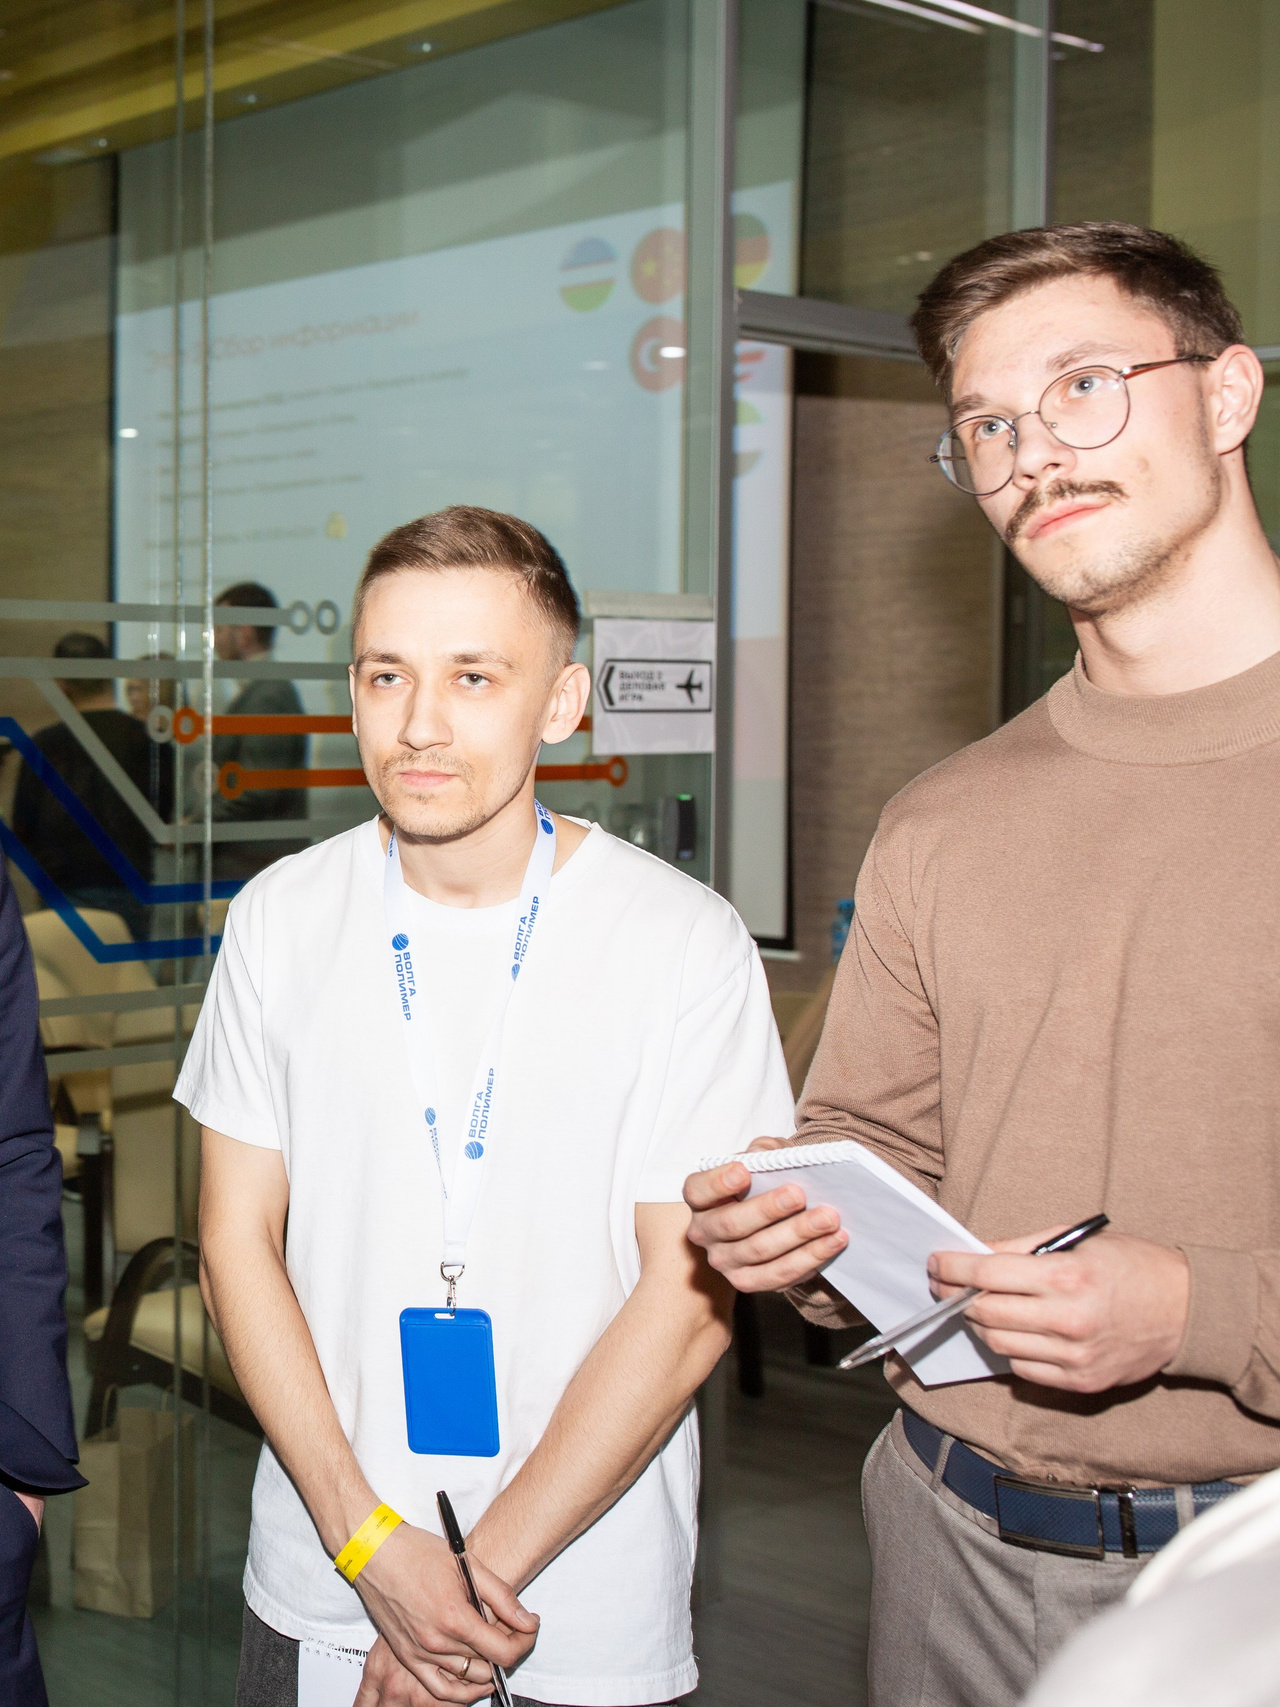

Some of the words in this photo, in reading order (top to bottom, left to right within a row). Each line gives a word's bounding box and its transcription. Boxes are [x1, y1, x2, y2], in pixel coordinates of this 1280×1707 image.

[513, 914, 528, 961] ВОЛГА
[518, 895, 540, 963] ПОЛИМЕР
[394, 953, 411, 1021] ПОЛИМЕР
[402, 951, 417, 998] ВОЛГА
[468, 1091, 484, 1138] ВОЛГА
[477, 1067, 495, 1139] ПОЛИМЕР
